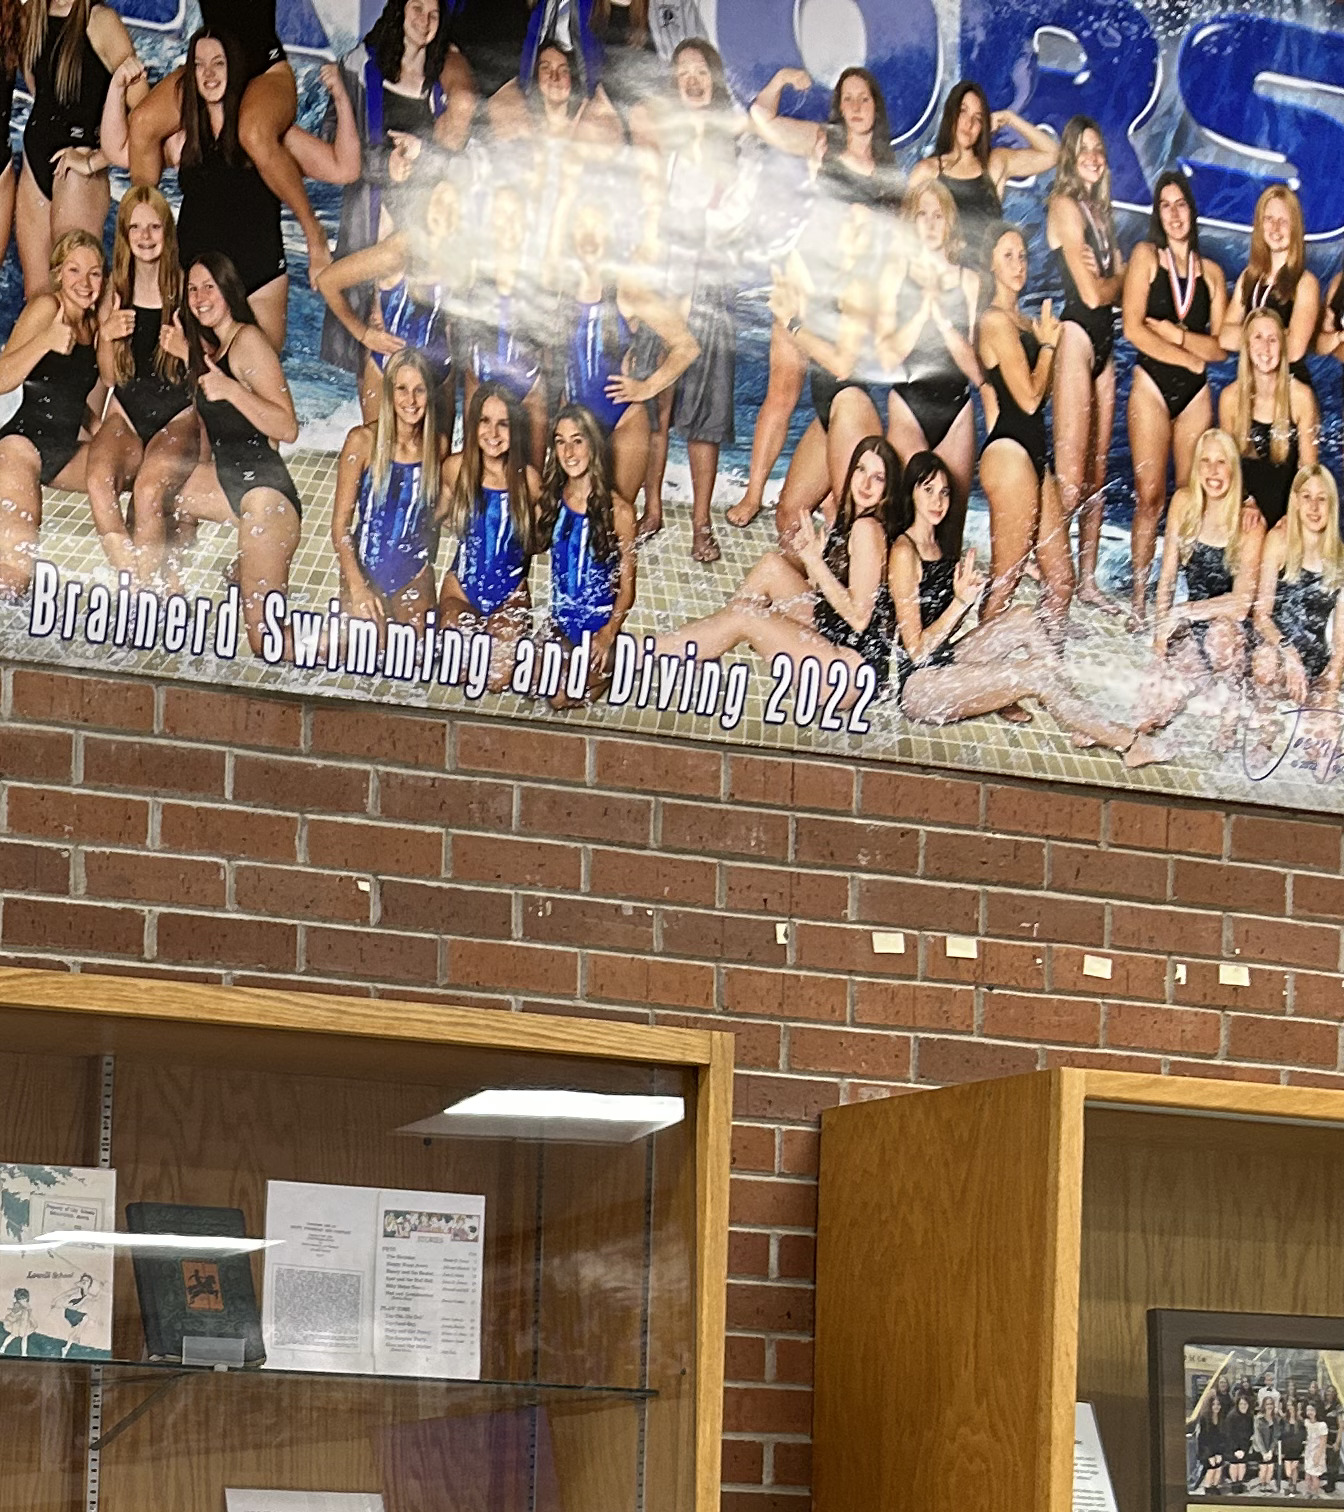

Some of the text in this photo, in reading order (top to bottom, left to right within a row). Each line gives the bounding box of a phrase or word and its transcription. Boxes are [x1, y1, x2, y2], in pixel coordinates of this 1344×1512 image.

[28, 560, 880, 735] Brainerd Swimming and Diving 2022
